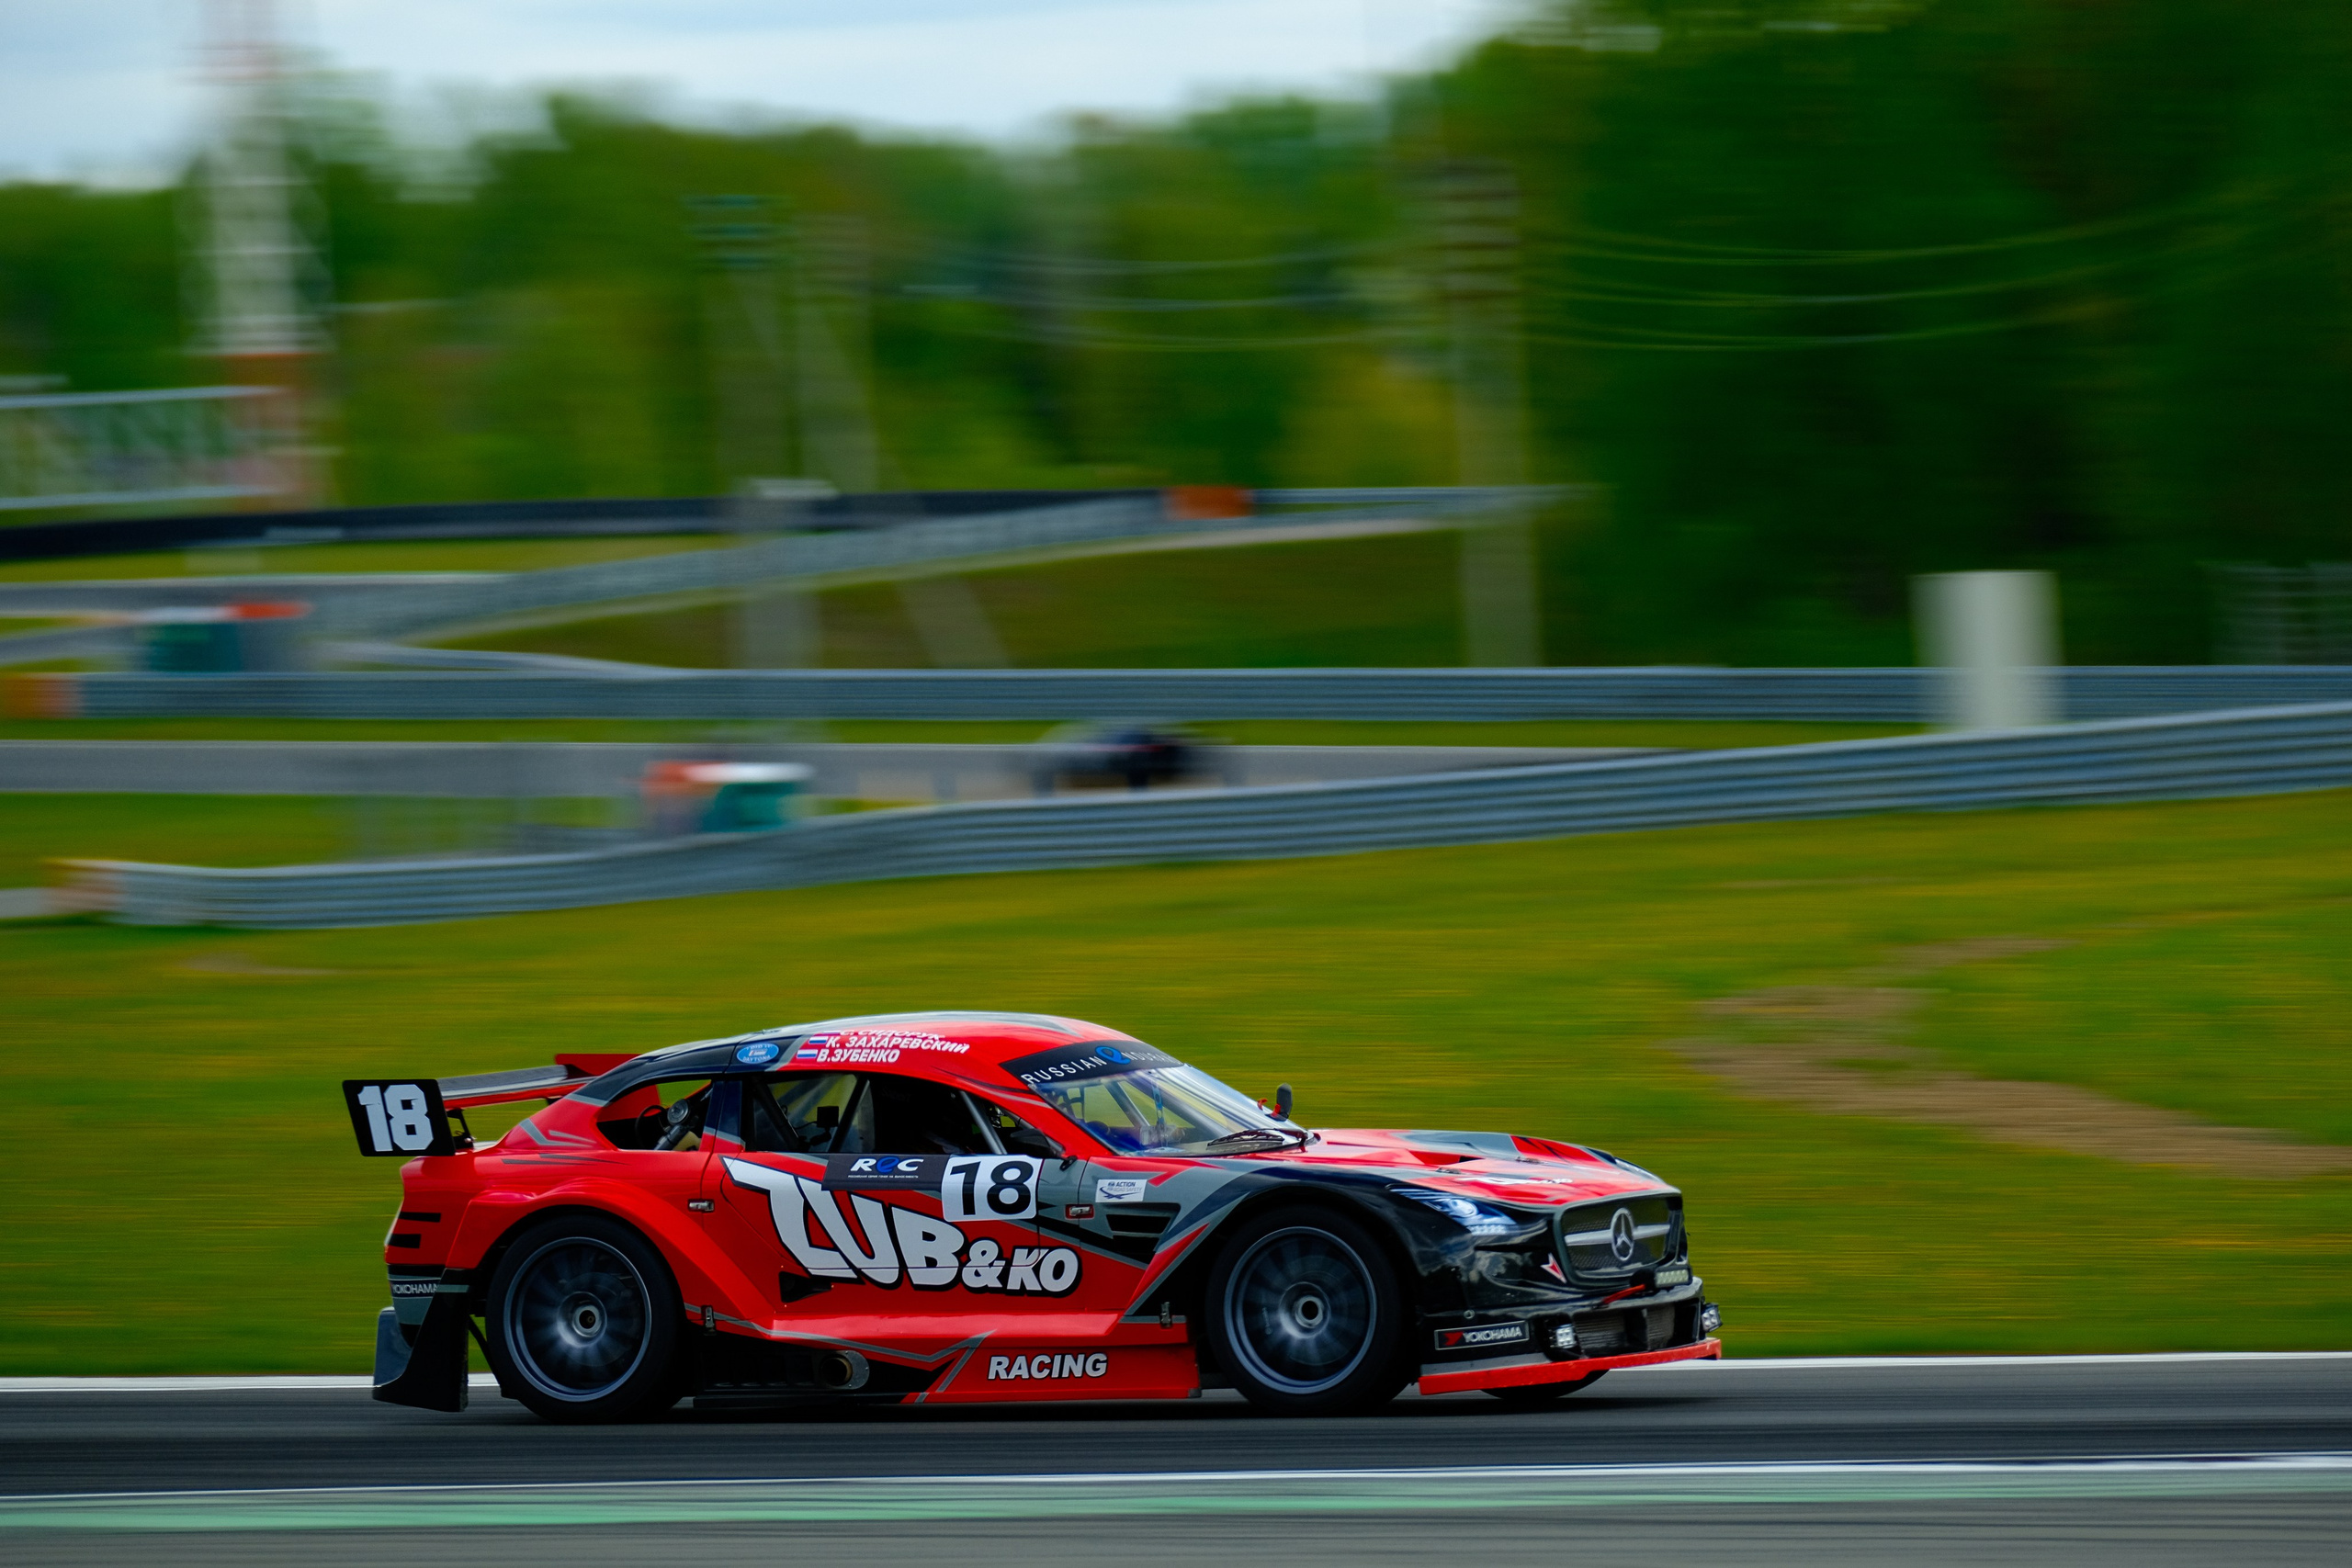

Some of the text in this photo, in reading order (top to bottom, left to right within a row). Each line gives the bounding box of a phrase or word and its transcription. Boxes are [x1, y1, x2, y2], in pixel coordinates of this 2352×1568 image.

[826, 1035, 840, 1048] К.
[1021, 1055, 1107, 1084] RUSSIAN
[357, 1084, 434, 1152] 18
[950, 1160, 1035, 1216] 18
[1462, 1325, 1523, 1344] YOKOHAMA
[988, 1352, 1108, 1380] RACING
